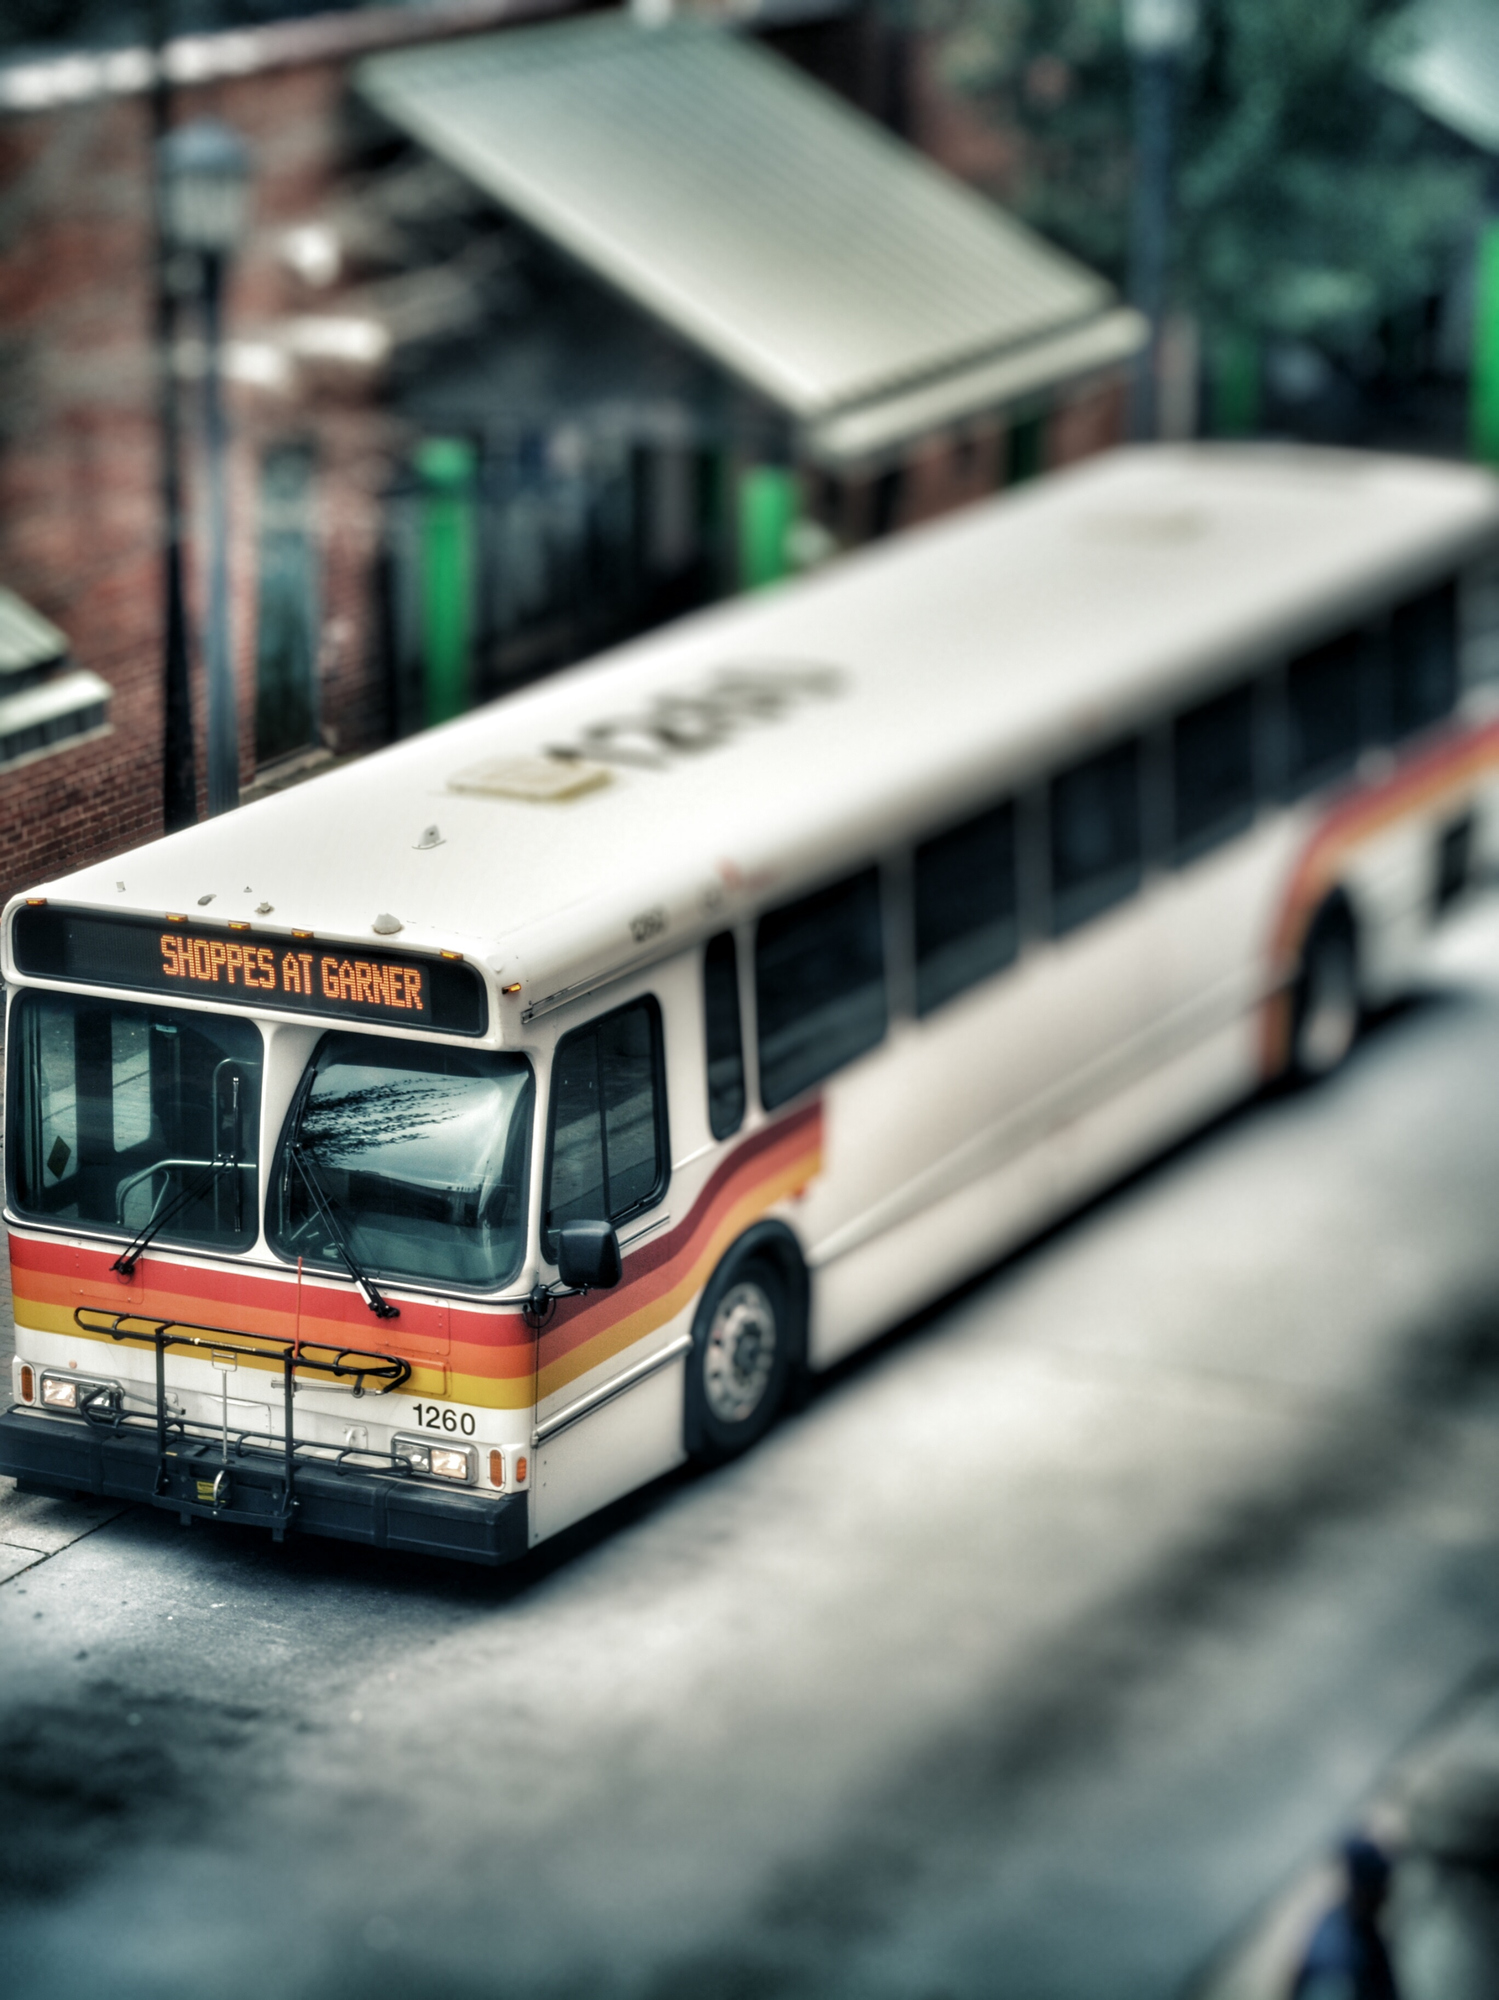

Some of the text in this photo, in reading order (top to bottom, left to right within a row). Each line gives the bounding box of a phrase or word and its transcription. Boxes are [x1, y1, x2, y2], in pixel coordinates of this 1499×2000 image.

[160, 934, 424, 1010] SHOPPES AT GARNER
[412, 1403, 476, 1436] 1260
